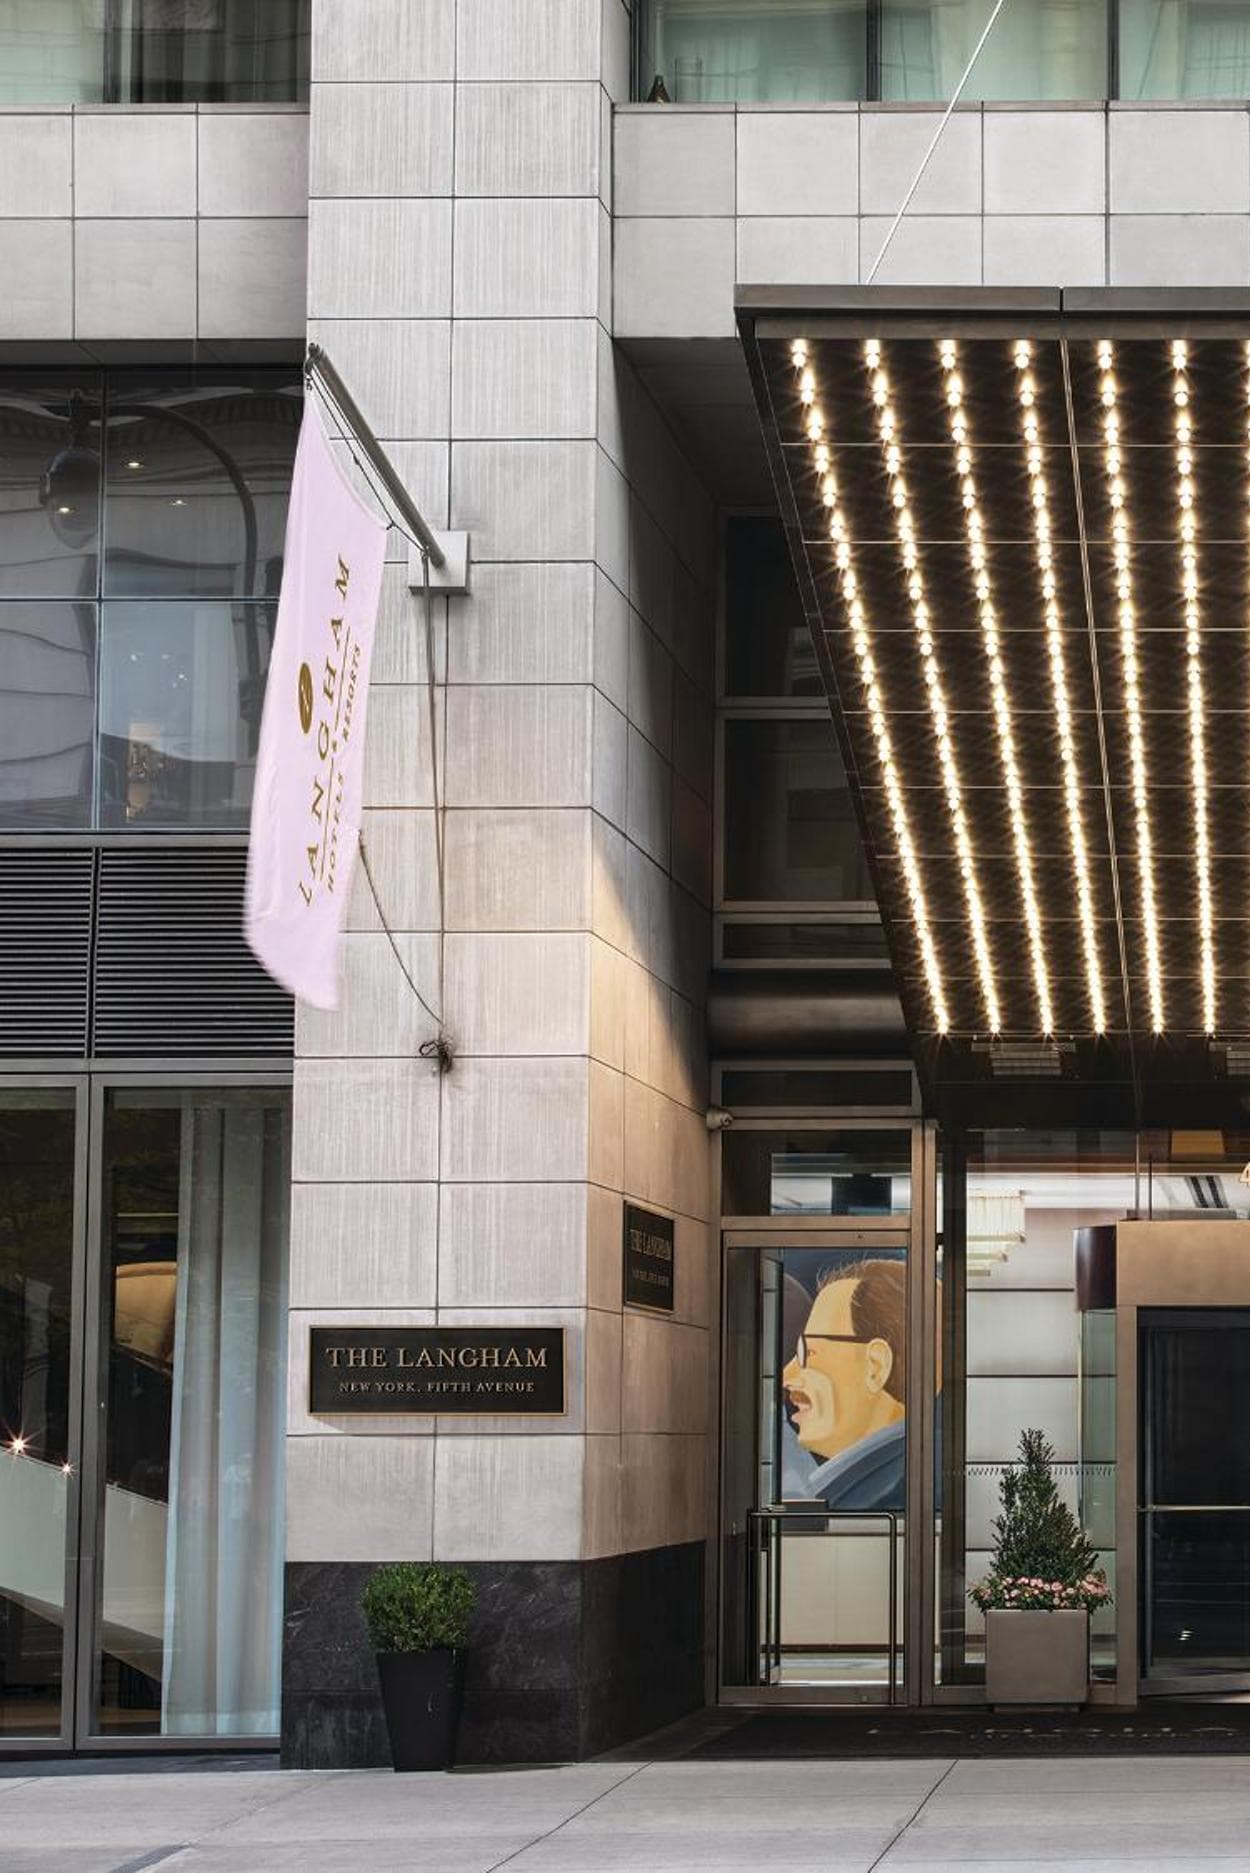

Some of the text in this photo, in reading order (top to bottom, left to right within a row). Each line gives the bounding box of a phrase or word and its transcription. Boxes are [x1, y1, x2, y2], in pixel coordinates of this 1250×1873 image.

[298, 552, 351, 907] LANGHAM
[326, 1347, 548, 1368] THE LANGHAM
[339, 1382, 370, 1393] NEW
[427, 1382, 471, 1393] FIFTH
[476, 1382, 535, 1393] AVENUE
